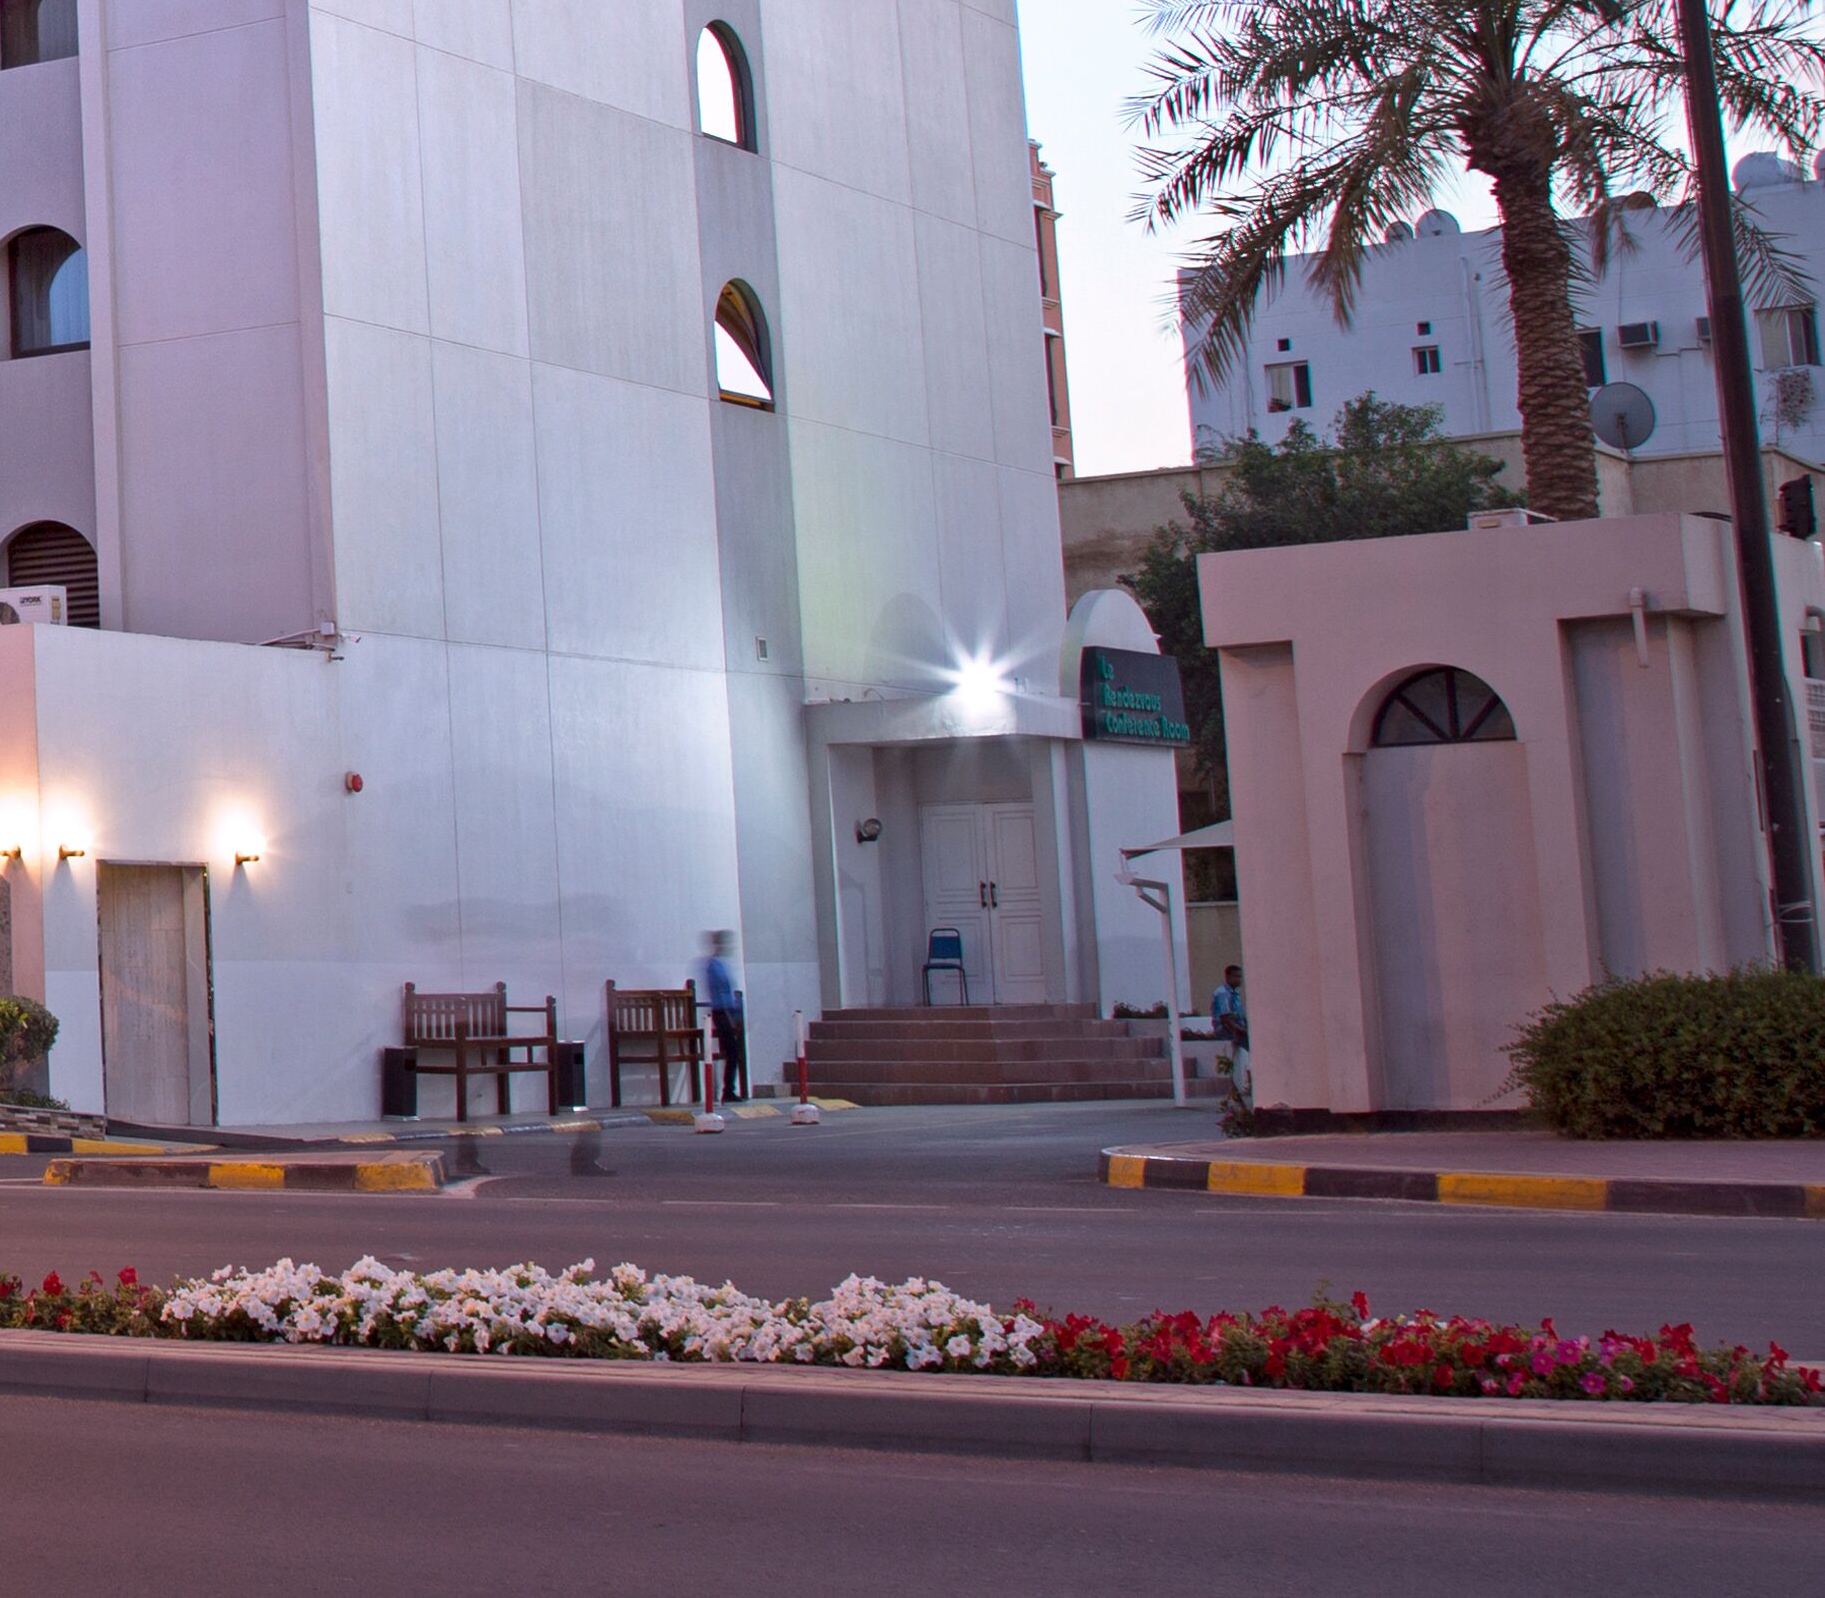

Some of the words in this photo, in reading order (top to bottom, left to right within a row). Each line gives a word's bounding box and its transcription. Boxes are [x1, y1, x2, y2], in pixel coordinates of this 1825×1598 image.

[1099, 657, 1114, 680] Le
[1102, 683, 1161, 711] Rendezvous
[1105, 710, 1160, 737] Conference
[1160, 715, 1190, 740] Room
